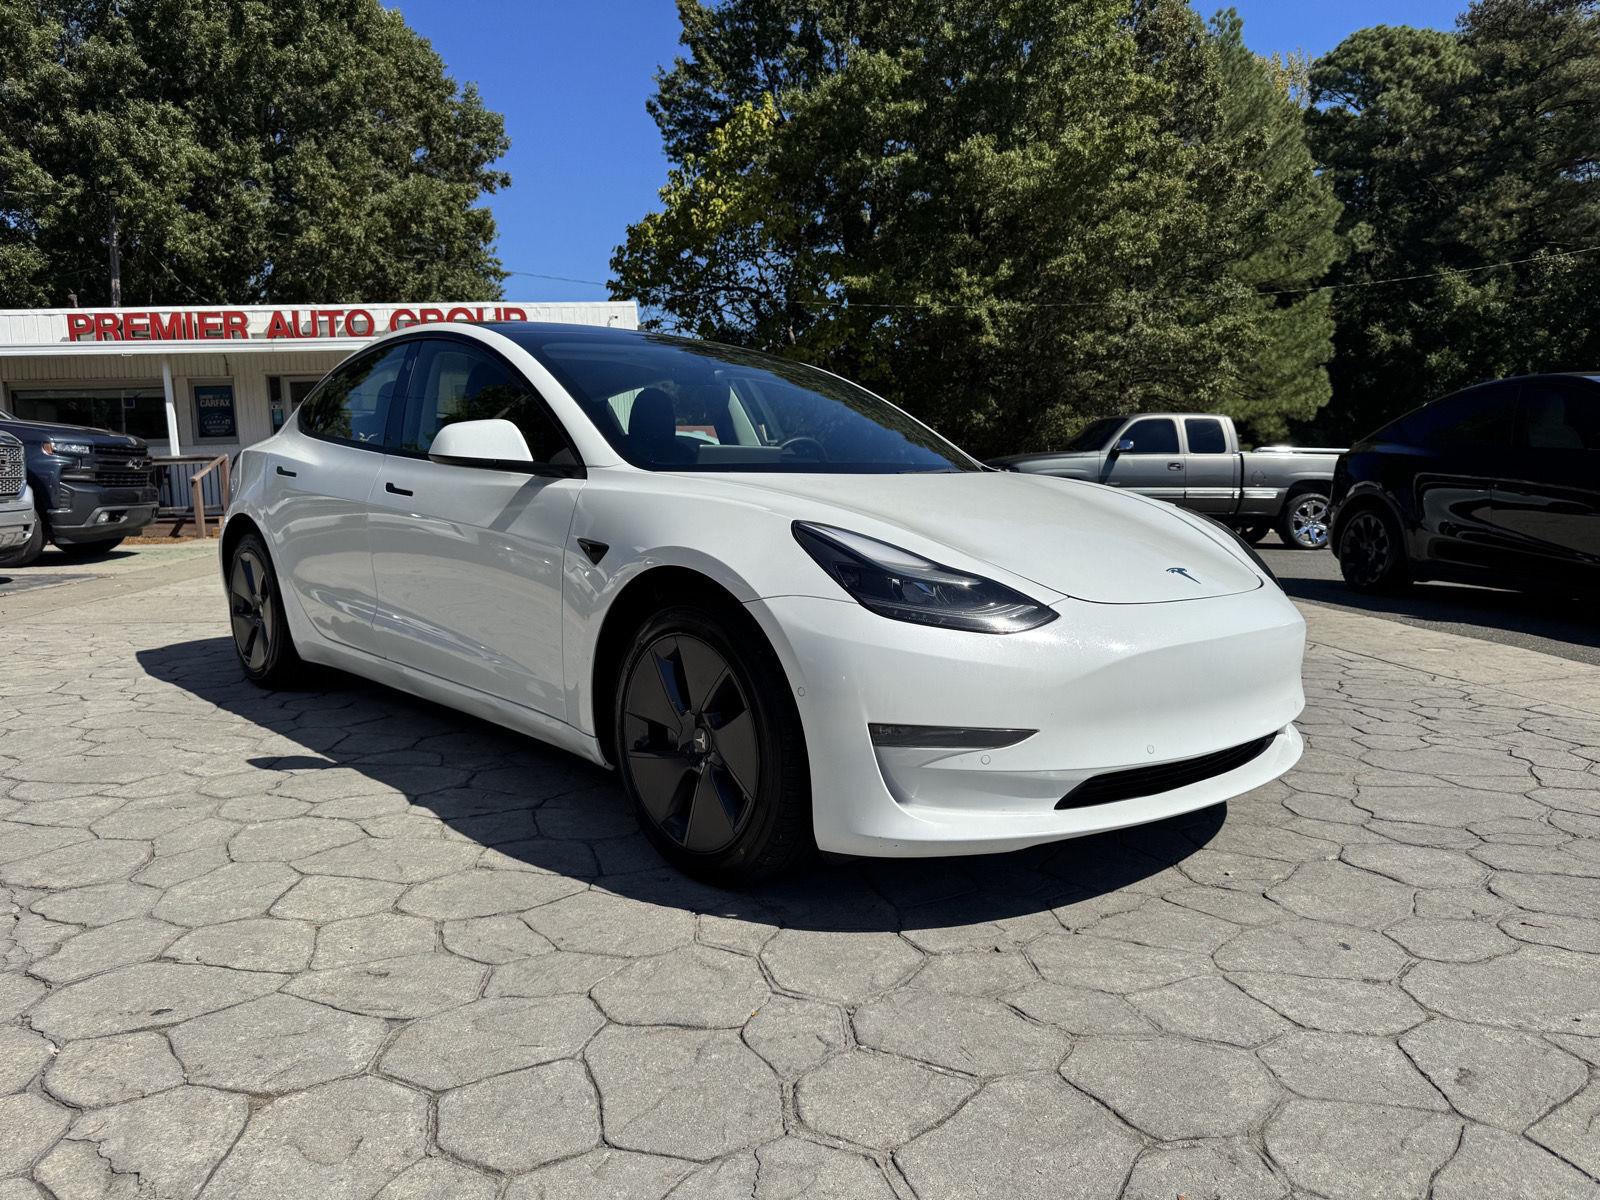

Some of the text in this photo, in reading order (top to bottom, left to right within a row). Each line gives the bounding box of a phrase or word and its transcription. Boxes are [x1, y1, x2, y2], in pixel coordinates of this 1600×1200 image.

[66, 311, 250, 341] PREMIER
[266, 308, 375, 338] AUTO
[200, 399, 231, 408] CARFAX
